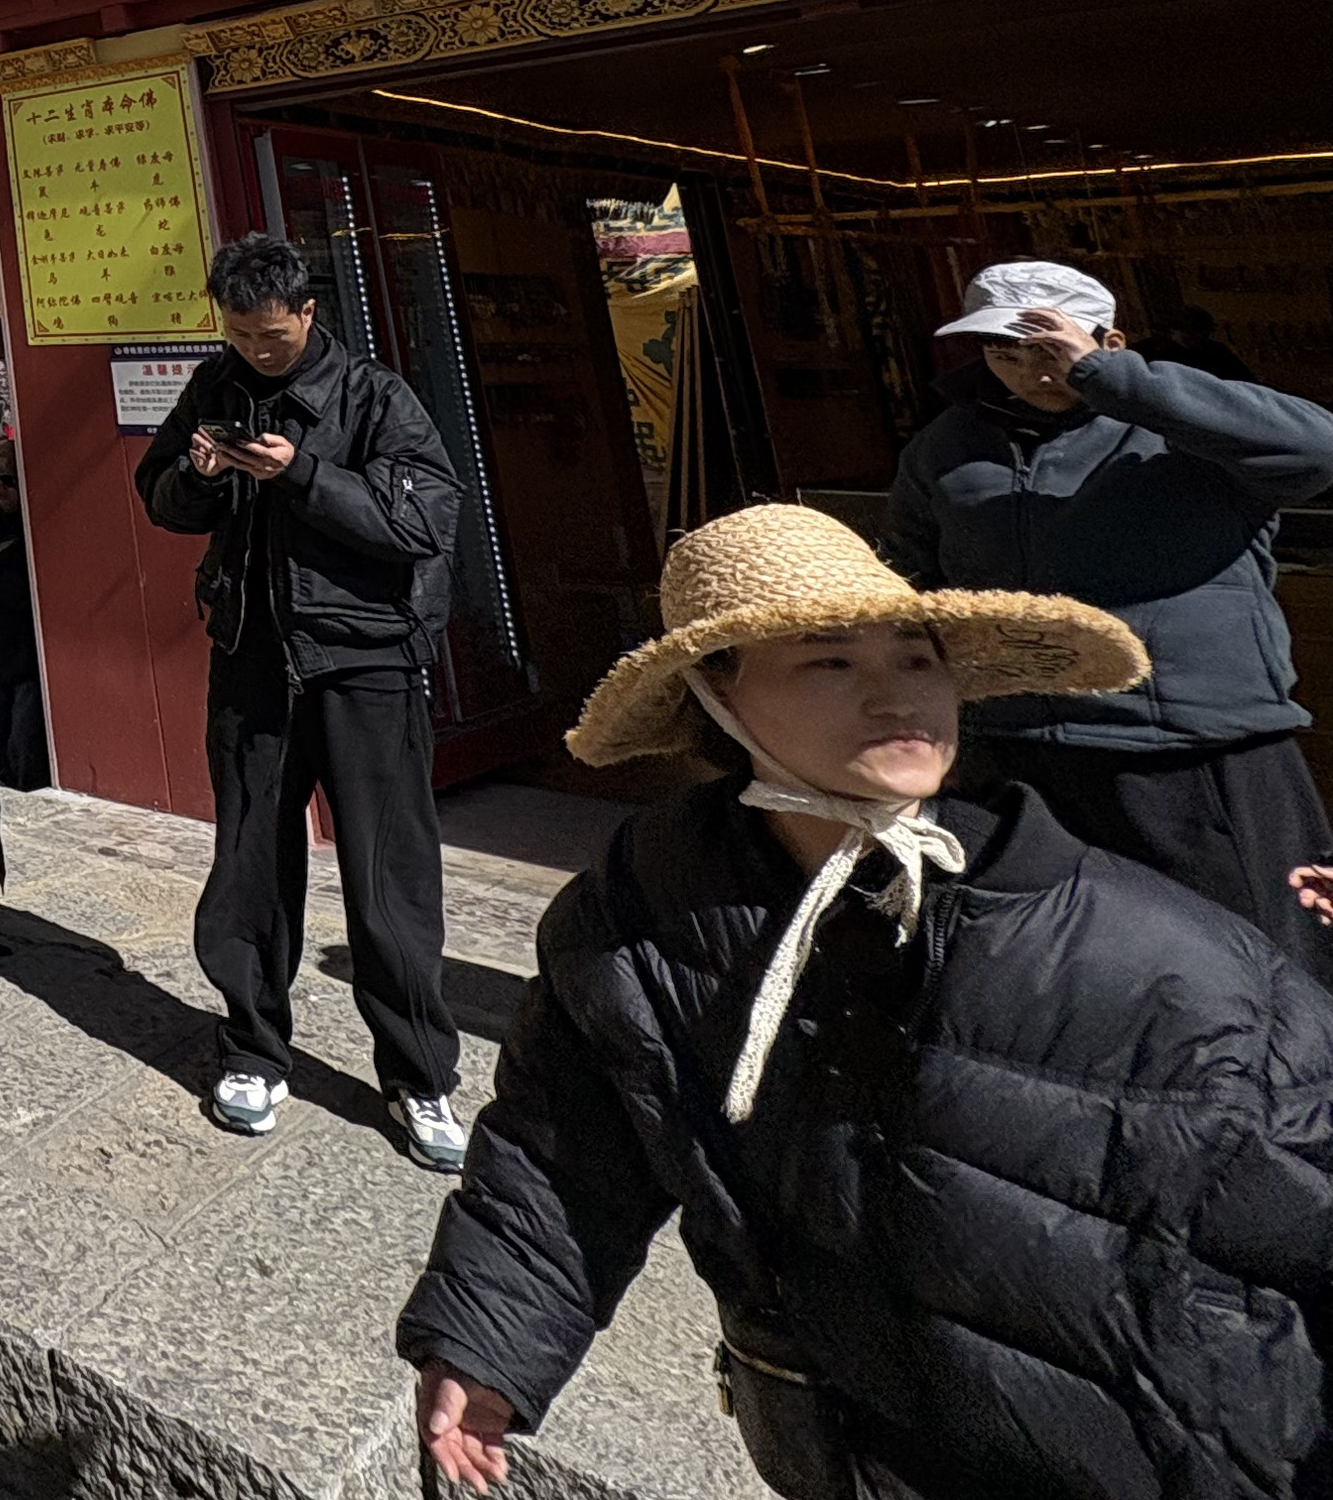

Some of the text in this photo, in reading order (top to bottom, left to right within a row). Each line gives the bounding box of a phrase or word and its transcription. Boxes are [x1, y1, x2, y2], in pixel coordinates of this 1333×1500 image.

[26, 88, 157, 125] 十二生肖本命佛
[90, 179, 99, 192] 牛
[157, 219, 171, 231] 蛇
